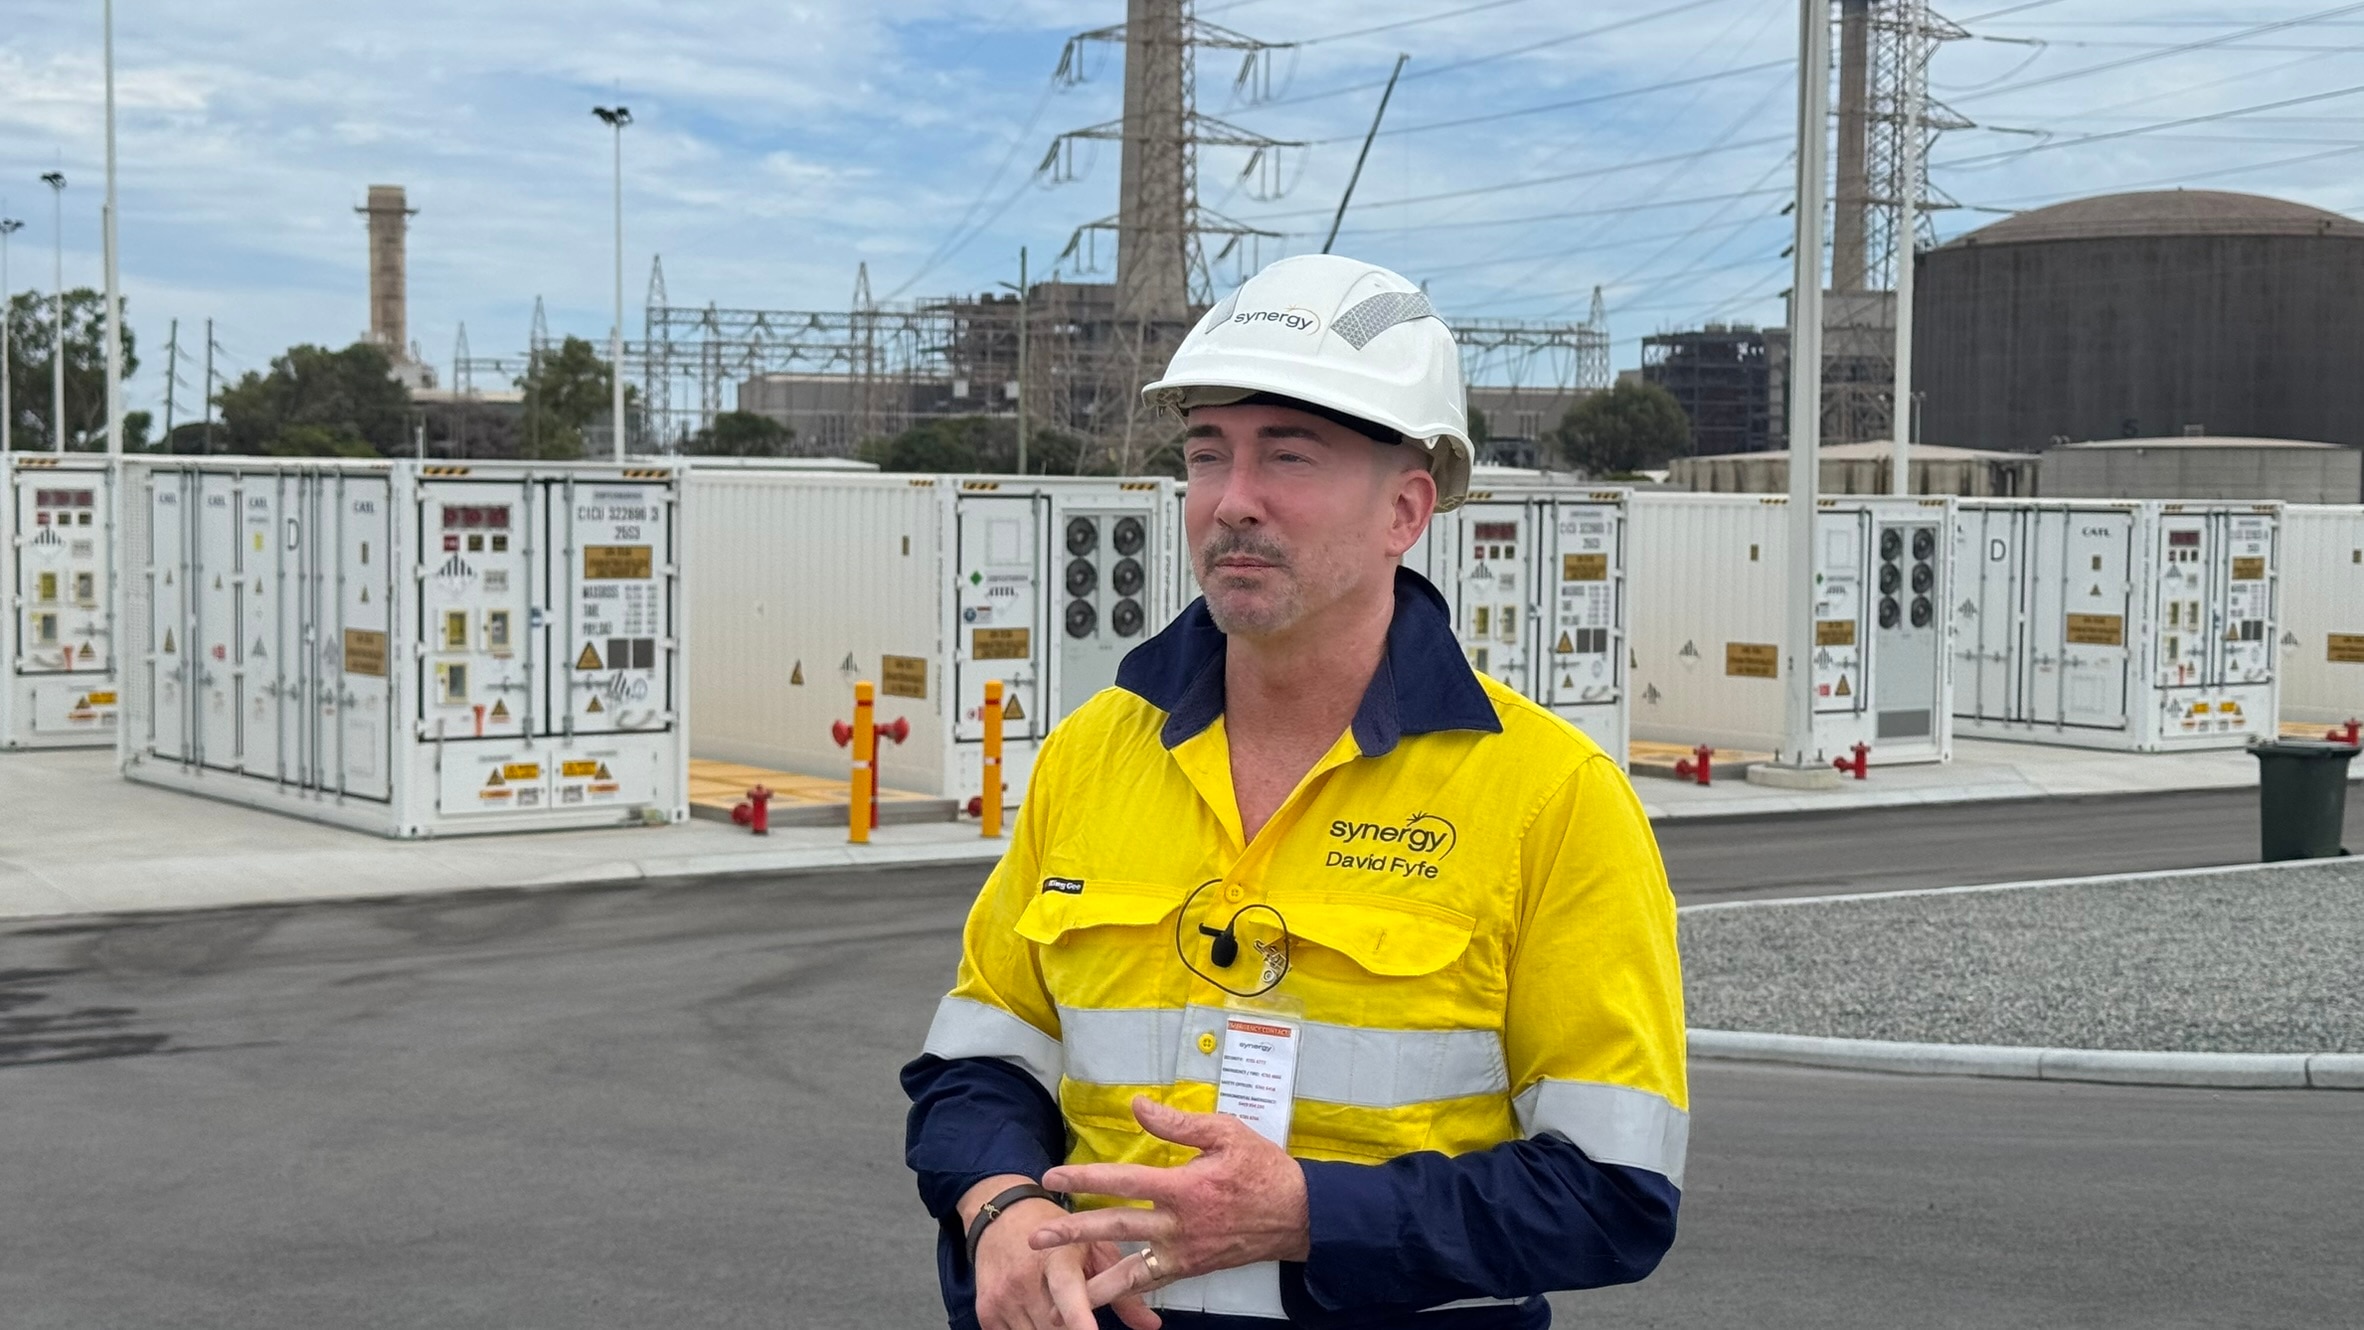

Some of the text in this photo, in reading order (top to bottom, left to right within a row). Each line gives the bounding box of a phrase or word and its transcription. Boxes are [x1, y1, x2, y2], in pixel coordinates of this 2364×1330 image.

[1234, 311, 1314, 331] synergy
[2082, 526, 2112, 538] CATL
[1330, 820, 1448, 852] synergy
[1325, 851, 1439, 879] David Fyfe
[1239, 1042, 1273, 1052] synergy
